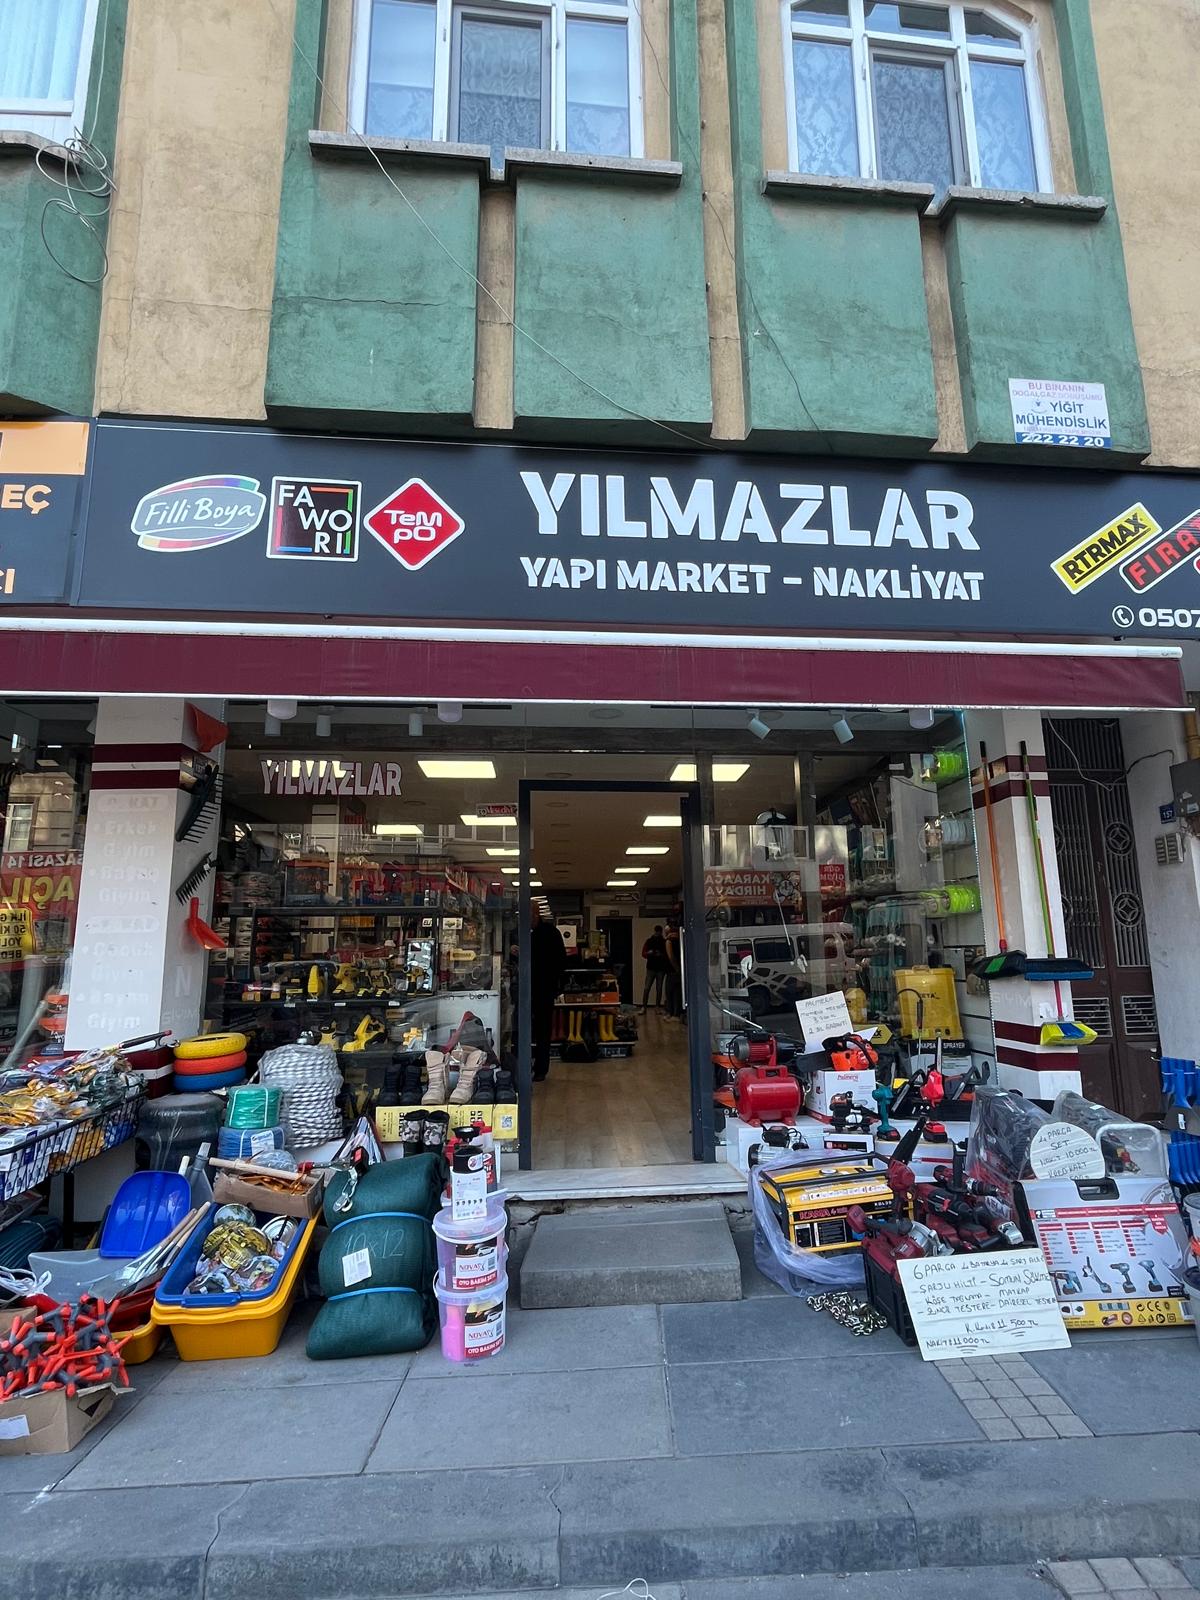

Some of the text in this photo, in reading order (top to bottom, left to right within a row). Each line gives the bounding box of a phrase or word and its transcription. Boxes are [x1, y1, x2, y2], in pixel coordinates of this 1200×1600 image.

[1050, 400, 1084, 414] YİĞİT
[1016, 413, 1107, 429] MÜHENDİSLİK
[1022, 433, 1105, 447] 222 22 20
[144, 498, 256, 527] Filli Boya
[520, 471, 981, 551] YILMAZLAR
[1062, 512, 1149, 580] RTRMAX
[520, 556, 606, 590] YAPI
[616, 560, 771, 594] MARKET
[813, 564, 984, 601] NAKLİYAT
[260, 760, 402, 796] YILMAZLAR
[1050, 1140, 1070, 1150] SET
[914, 1264, 924, 1280] 6
